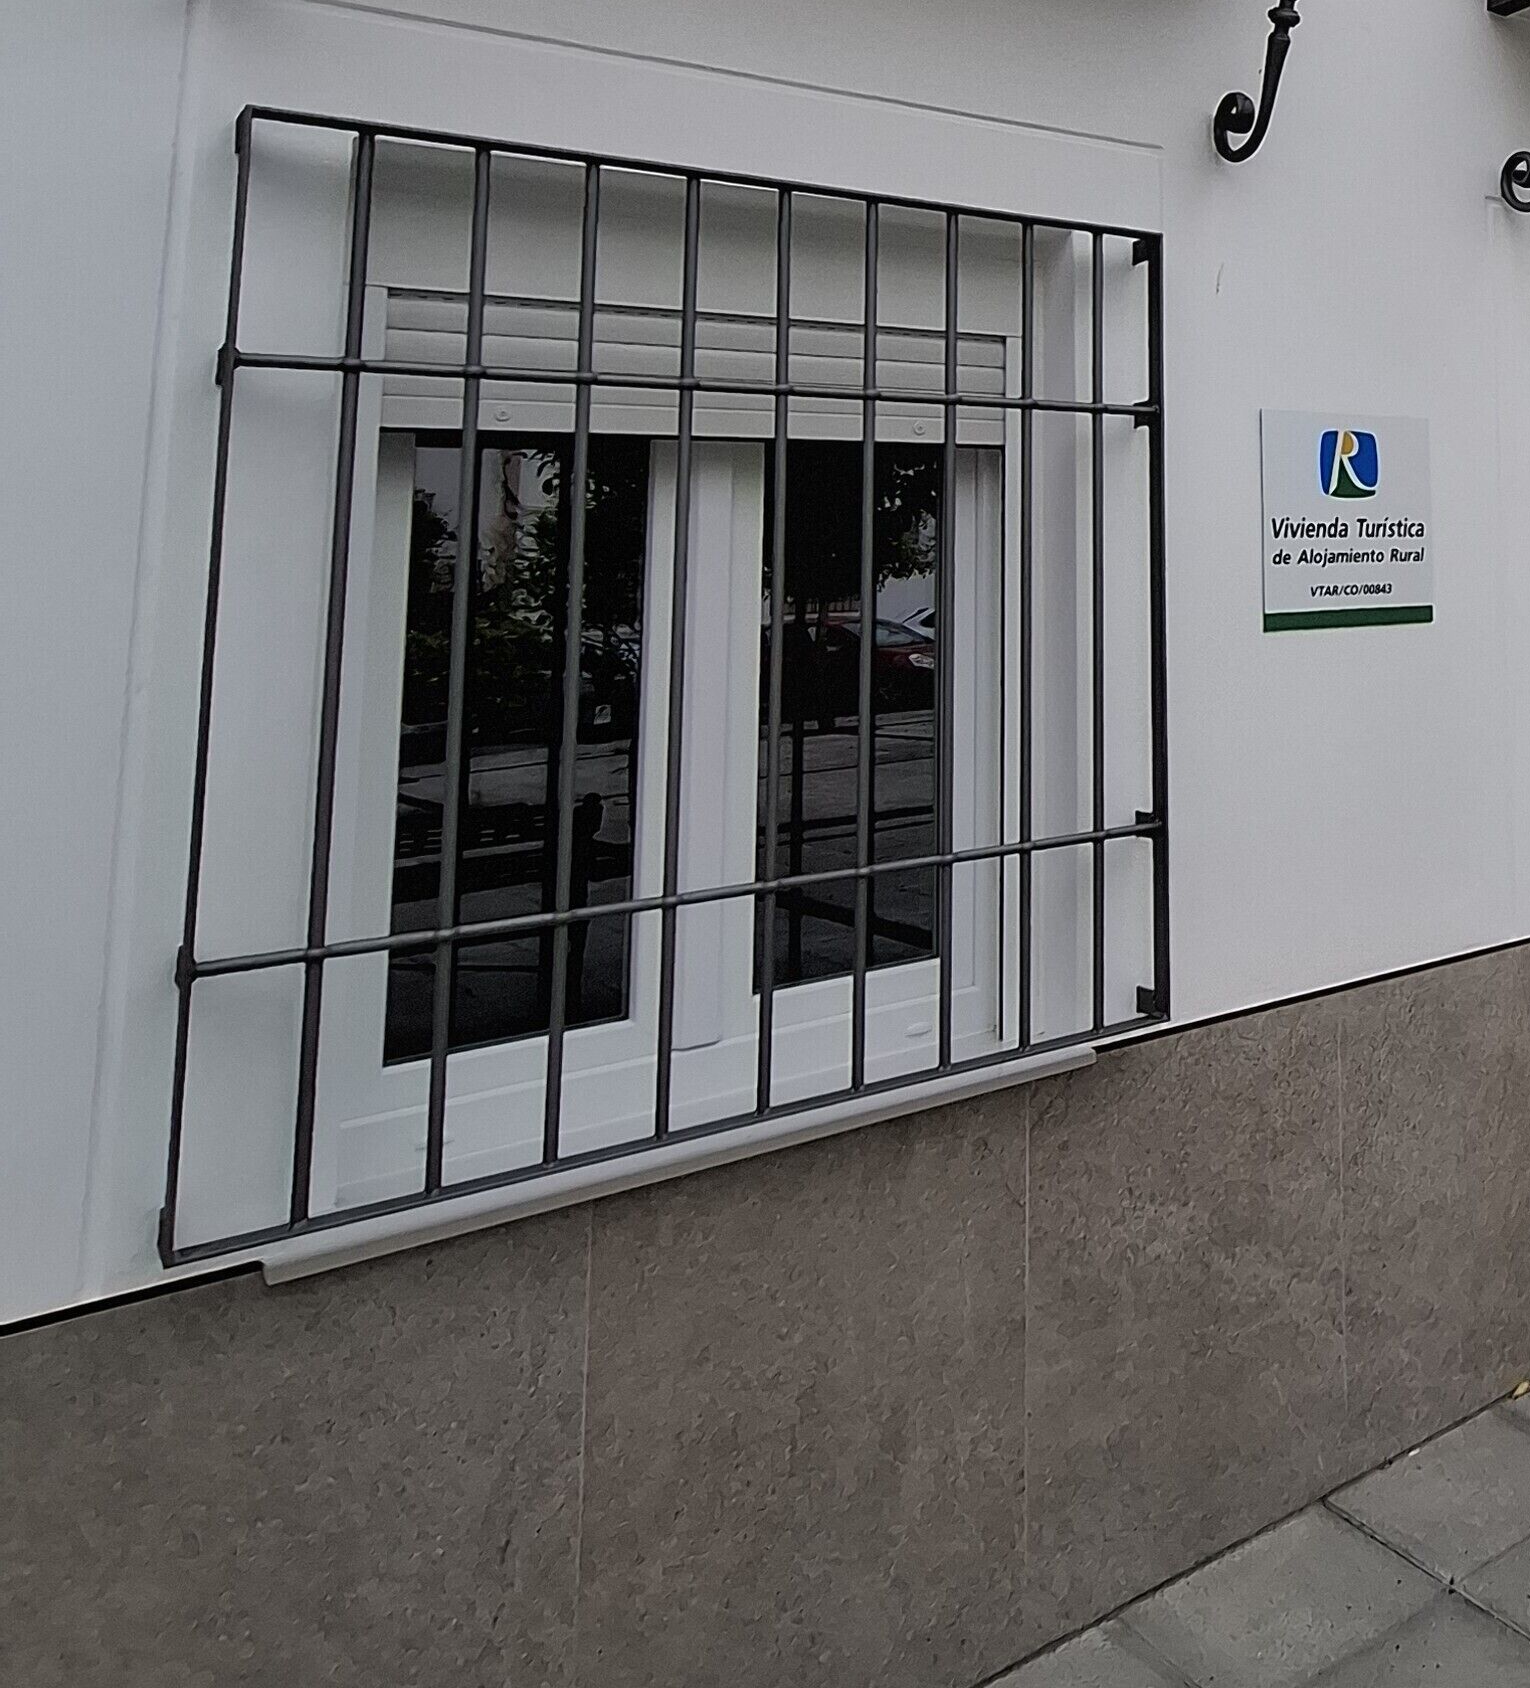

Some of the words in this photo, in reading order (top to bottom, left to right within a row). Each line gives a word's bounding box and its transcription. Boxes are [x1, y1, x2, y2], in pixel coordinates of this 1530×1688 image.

[1271, 517, 1349, 539] Vivienda
[1356, 517, 1425, 538] Turística
[1272, 548, 1291, 565] de
[1297, 548, 1385, 568] Alojamiento
[1389, 547, 1424, 563] Rural
[1310, 583, 1392, 597] VTAR/CO/00843
